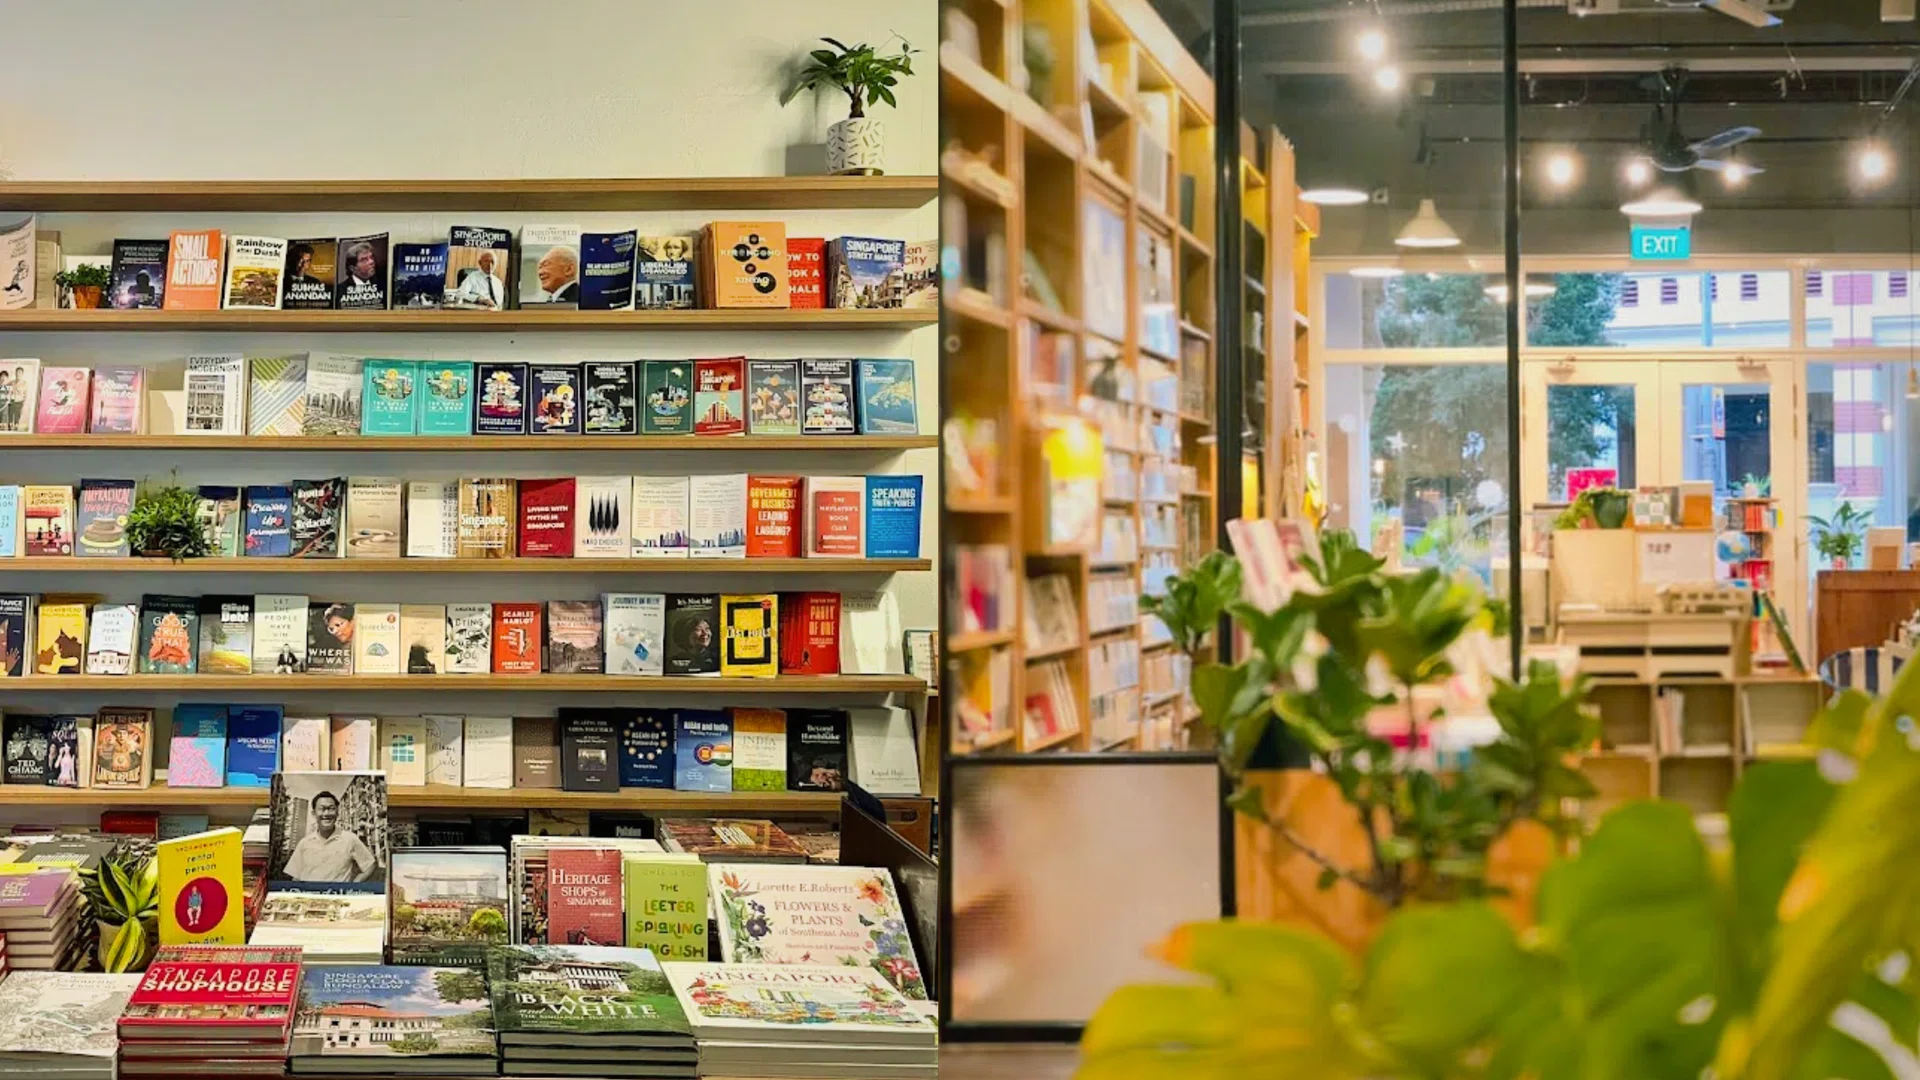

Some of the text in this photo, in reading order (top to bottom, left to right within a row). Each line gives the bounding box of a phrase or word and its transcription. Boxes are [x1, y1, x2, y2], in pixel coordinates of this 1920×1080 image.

[454, 230, 506, 242] SINGAPORE
[175, 235, 209, 260] SMALL
[236, 239, 283, 250] Rainbow
[464, 239, 495, 248] STORY
[846, 240, 902, 254] SINGAPORE
[1642, 235, 1678, 254] EXIT
[254, 248, 280, 258] Dusk
[786, 253, 820, 262] OW TO
[848, 252, 898, 262] STREET NAMES
[904, 256, 928, 266] City
[172, 259, 218, 285] ACTIONS
[788, 270, 808, 278] OOK
[291, 283, 326, 292] SUBHAS
[347, 284, 378, 294] SUBHAS
[789, 285, 820, 293] HALE
[285, 292, 331, 300] ANANDAN
[340, 291, 383, 302] ANANDAN
[700, 375, 736, 384] SINGAPORE
[750, 488, 797, 498] GOVERNMENT
[872, 488, 916, 500] SPEAKING
[752, 499, 796, 510] IN BUSINESS
[872, 500, 916, 508] TRUTH POWER
[461, 514, 508, 528] Singapore,
[758, 512, 788, 522] LEADING
[296, 518, 332, 529] Redacted
[756, 526, 792, 536] LAGGING?
[222, 612, 249, 622] Debt
[810, 605, 835, 620] PARTY
[152, 616, 189, 626] GOOD
[455, 618, 484, 626] DYING
[156, 627, 184, 635] TRUE
[809, 622, 836, 636] OF ONE
[158, 638, 183, 646] THAI
[309, 648, 350, 657] WHERE
[684, 721, 728, 730] ASEAN and India
[807, 724, 834, 733] Beyond
[742, 736, 776, 746] INDIA
[8, 766, 44, 774] CHIANG
[187, 852, 215, 862] rental
[185, 864, 217, 876] person
[552, 869, 612, 884] HERITAGE
[562, 886, 598, 896] SHOPS
[757, 883, 796, 892] Lorette
[567, 898, 614, 906] SINGAPORE
[774, 902, 852, 912] FLOWERS &
[644, 900, 695, 916] LEETER
[791, 914, 844, 926] PLANTS
[778, 927, 860, 938] of Southeast Asia
[204, 936, 224, 944] does
[636, 942, 704, 958] SINGLISH
[150, 967, 294, 983] SINGAPORE
[700, 971, 865, 984] SINGAPORE
[142, 979, 292, 992] SHOPHOUSE
[519, 994, 624, 1006] BLACK
[548, 1004, 657, 1016] WHITE
